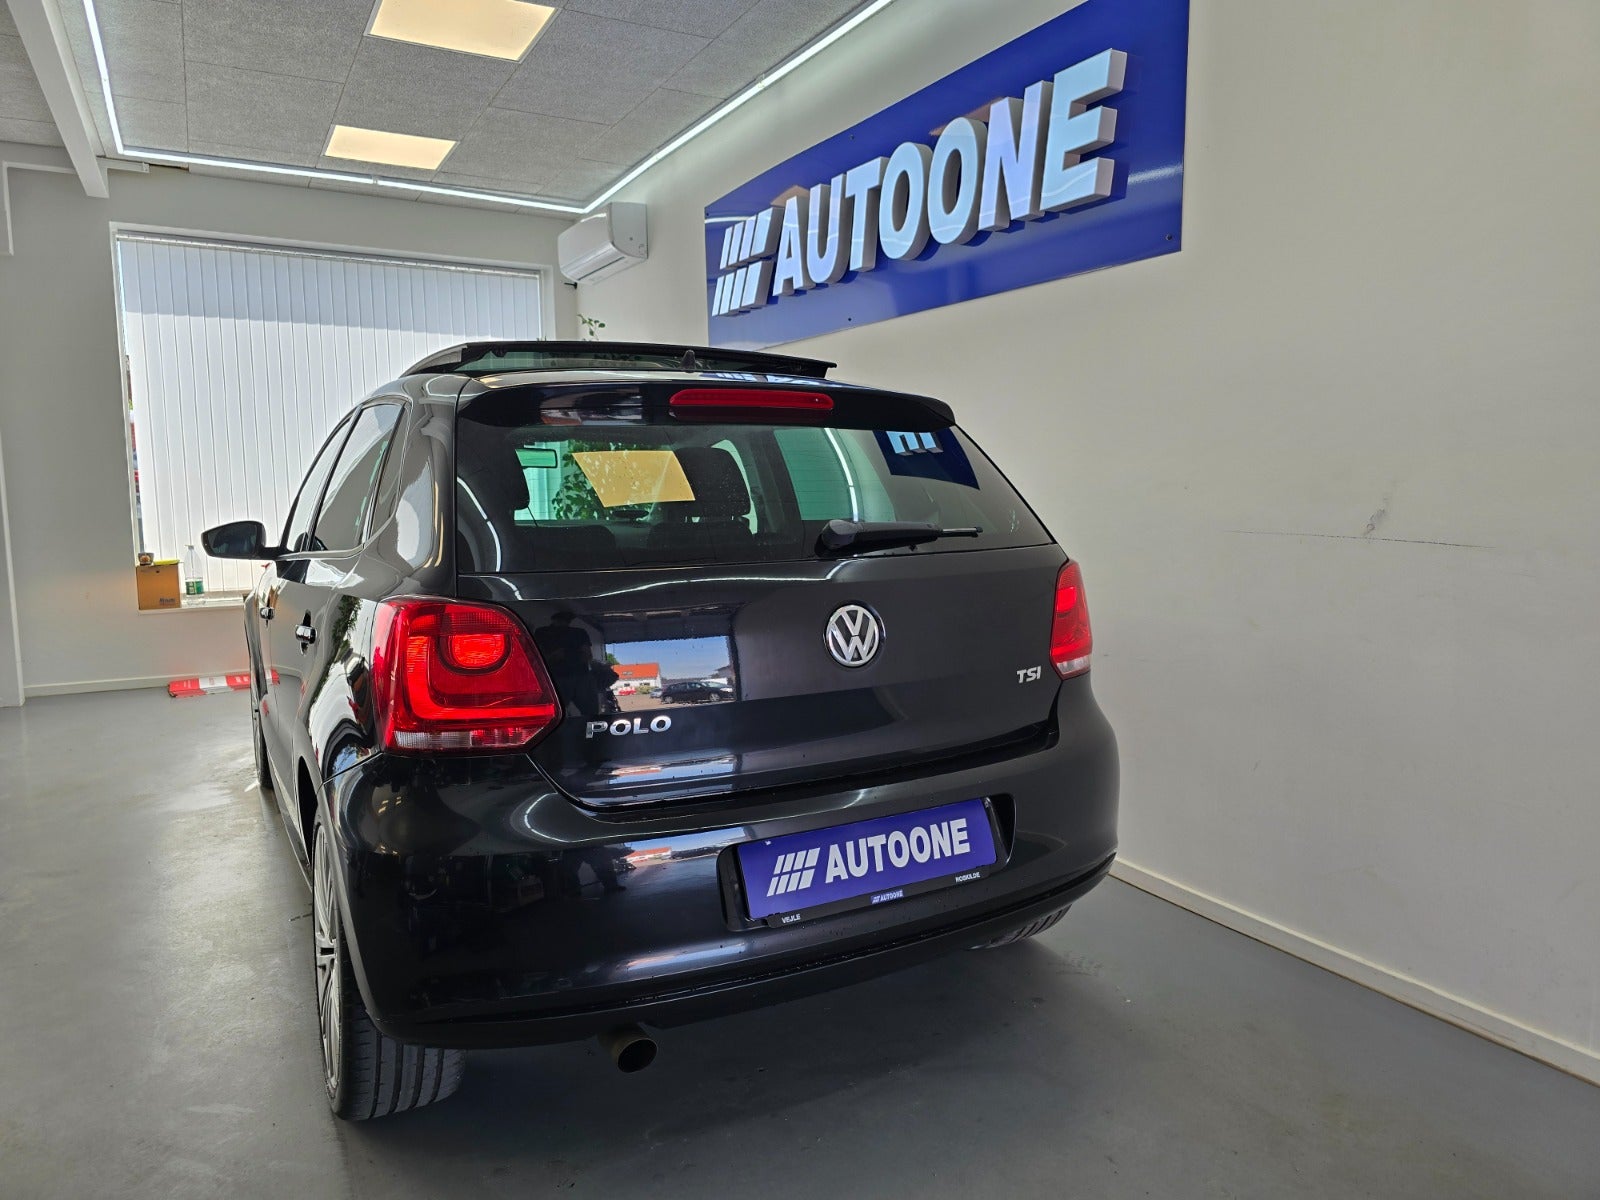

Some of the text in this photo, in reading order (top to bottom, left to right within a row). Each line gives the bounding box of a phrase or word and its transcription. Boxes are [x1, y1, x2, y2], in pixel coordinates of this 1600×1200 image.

[773, 48, 1127, 296] AUTOONE
[826, 604, 880, 667] VW
[1016, 665, 1042, 684] TSI
[585, 715, 672, 739] POLO
[825, 818, 971, 884] AUTOONE
[781, 913, 801, 924] VEJLE
